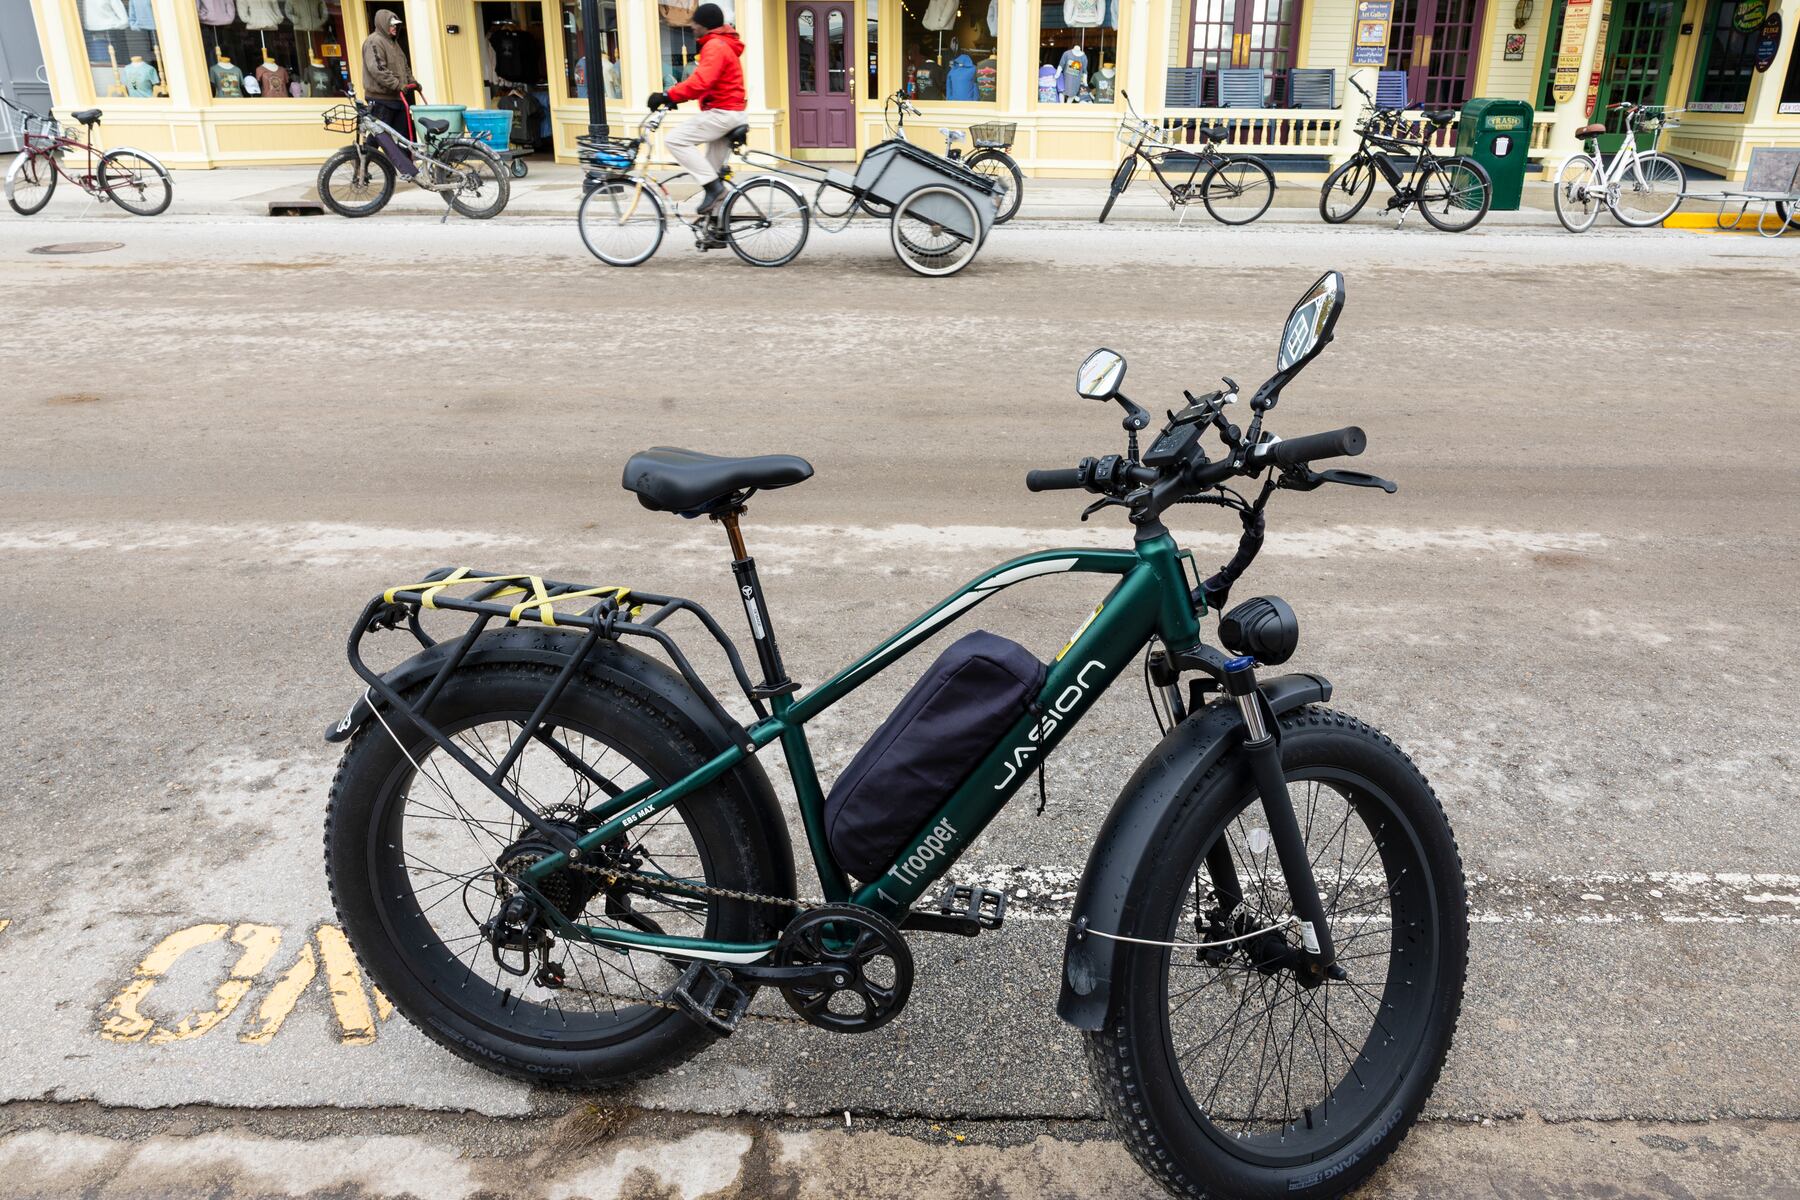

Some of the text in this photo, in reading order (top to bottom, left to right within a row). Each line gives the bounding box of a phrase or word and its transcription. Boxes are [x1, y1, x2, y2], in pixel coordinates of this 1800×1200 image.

[1491, 117, 1518, 125] TRASH
[993, 659, 1107, 791] JASION
[621, 803, 656, 827] EB5 MAX
[887, 816, 958, 886] Trooper
[1324, 1107, 1404, 1180] CHAO YANG
